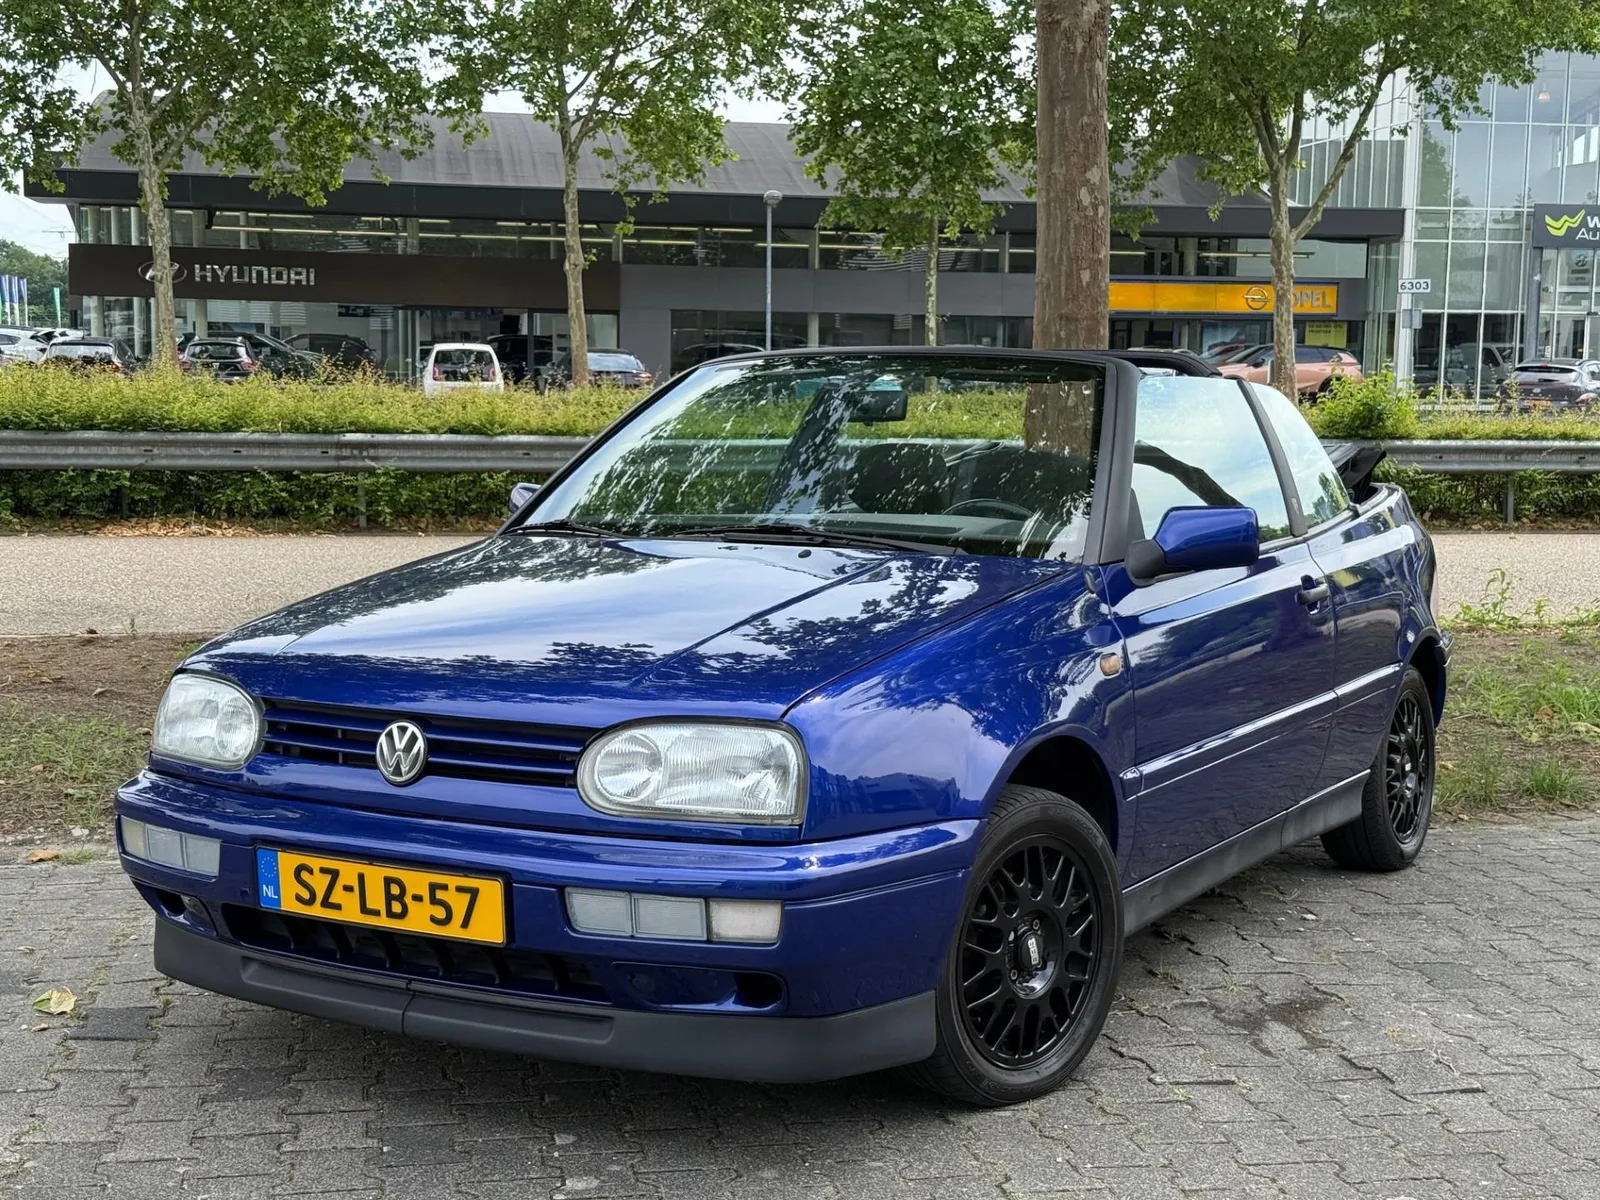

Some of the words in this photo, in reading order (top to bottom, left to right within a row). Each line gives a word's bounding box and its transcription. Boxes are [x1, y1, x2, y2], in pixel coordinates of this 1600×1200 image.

[194, 264, 315, 285] HYUNDAI
[1400, 281, 1429, 290] 6303
[263, 885, 278, 899] NL
[293, 863, 480, 929] SZ-LB-57
